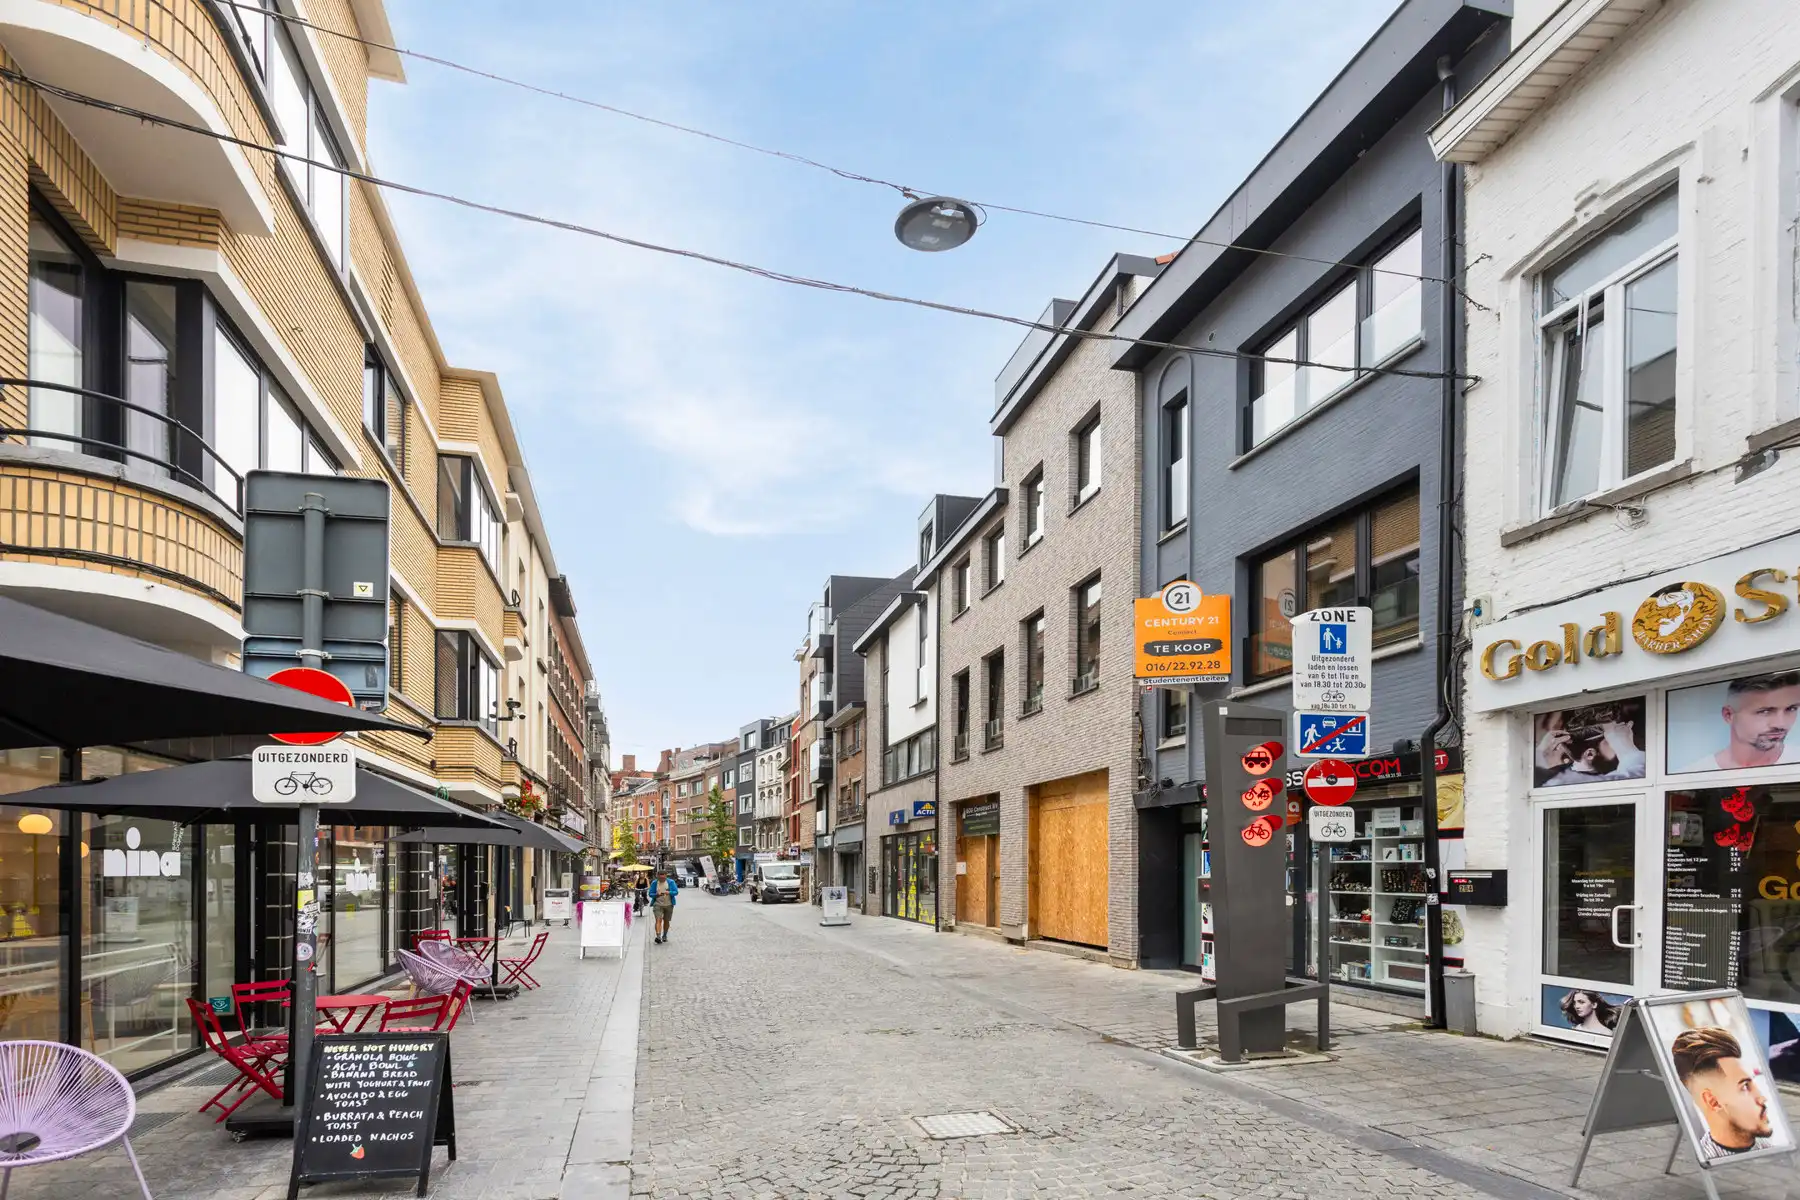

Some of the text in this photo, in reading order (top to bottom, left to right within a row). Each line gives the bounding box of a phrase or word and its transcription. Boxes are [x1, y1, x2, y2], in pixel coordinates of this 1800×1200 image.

[1308, 610, 1356, 622] ZONE
[1144, 616, 1219, 627] CENTURY 21
[1153, 643, 1211, 653] TE KOOP
[1480, 611, 1623, 681] Gold
[1311, 655, 1355, 664] Uitgezonderd
[1145, 660, 1221, 672] 016/22.92.28
[1143, 675, 1226, 685] Studentenentiteiten
[258, 752, 349, 763] UITGEZONDERD
[1313, 810, 1352, 818] UITGEZONDERD
[103, 826, 181, 877] nina
[323, 1043, 434, 1054] NEVER NOT HUNGRY
[333, 1052, 418, 1062] GRANOLA BOWL
[369, 1062, 402, 1070] BOWL
[330, 1070, 418, 1078] BANANA BREAD
[357, 1080, 396, 1088] YOGHURT
[326, 1092, 375, 1101] AVOCADO
[334, 1099, 369, 1108] TOAST
[324, 1110, 423, 1121] BURRATA & PEACH
[325, 1122, 360, 1130] TOAST
[320, 1132, 414, 1143] LOADED NACHOS
